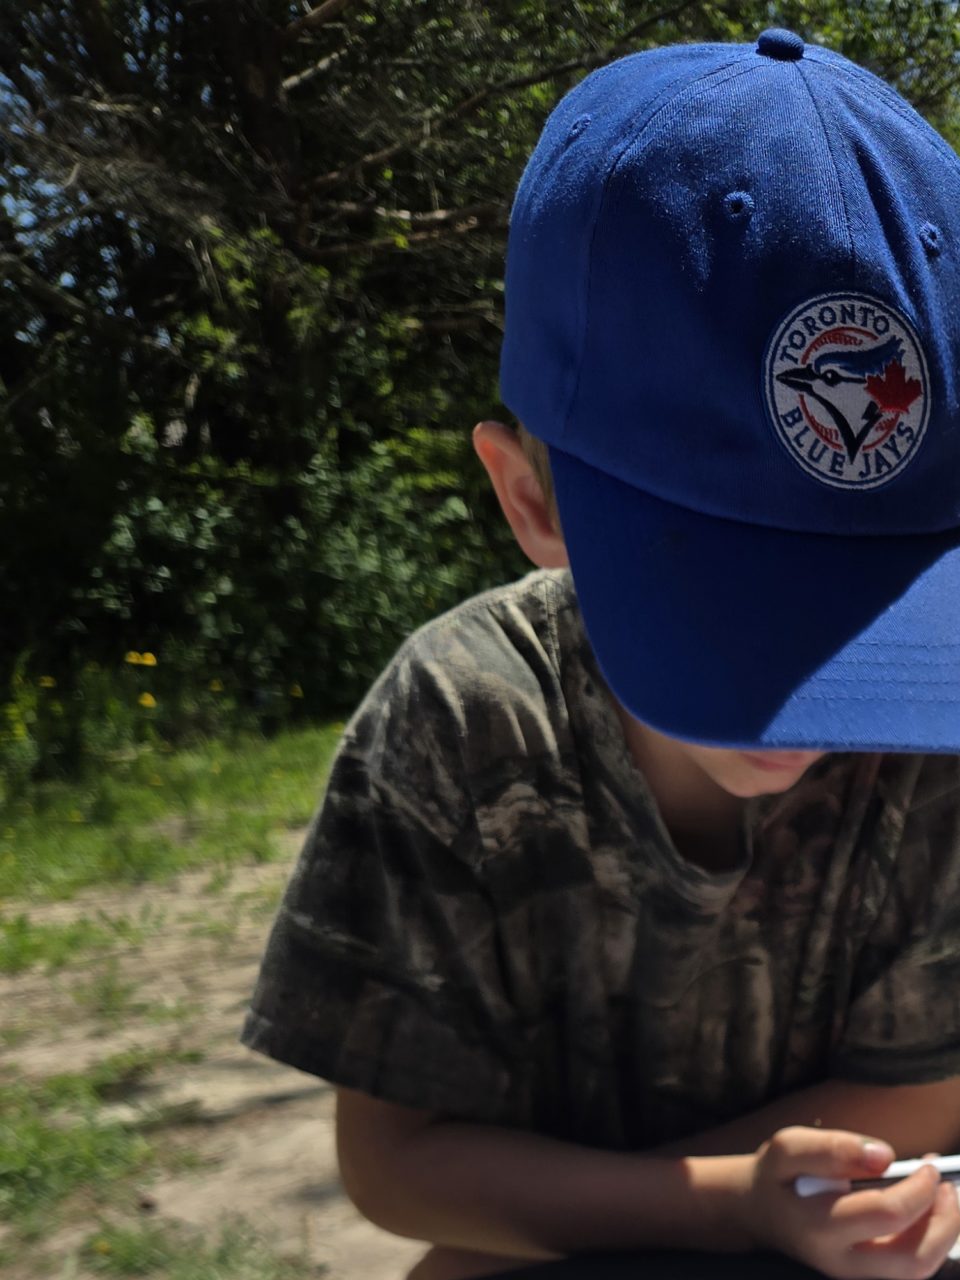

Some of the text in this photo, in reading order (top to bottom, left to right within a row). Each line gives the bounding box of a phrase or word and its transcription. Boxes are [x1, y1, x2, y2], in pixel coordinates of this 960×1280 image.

[780, 304, 890, 365] TORONTO
[781, 406, 915, 478] BLUE JAYS
